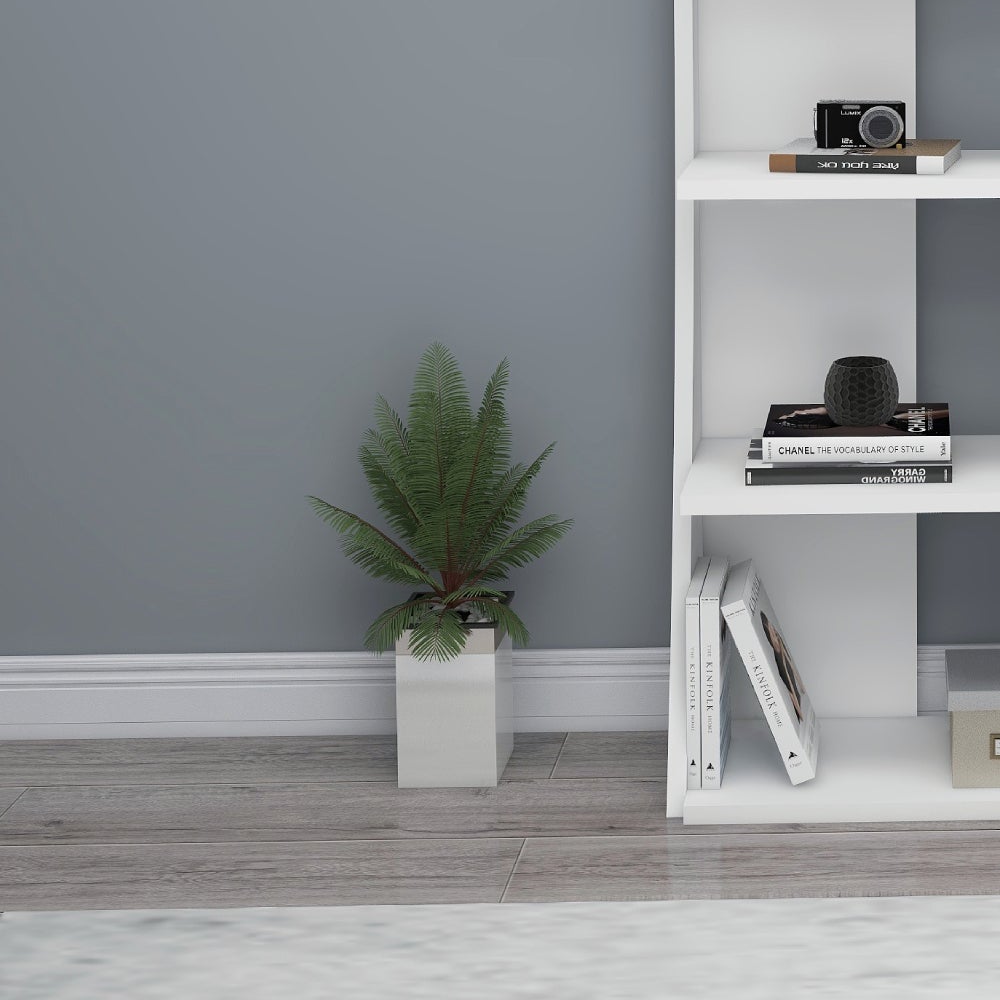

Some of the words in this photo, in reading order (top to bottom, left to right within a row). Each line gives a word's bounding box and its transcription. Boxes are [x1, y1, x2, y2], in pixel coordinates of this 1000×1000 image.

[908, 406, 926, 433] CHANEL
[778, 446, 815, 455] CHANEL
[817, 446, 832, 454] THE
[834, 446, 886, 454] VOCABULARY
[901, 445, 925, 453] STYLE
[753, 664, 777, 710] KINFOLK
